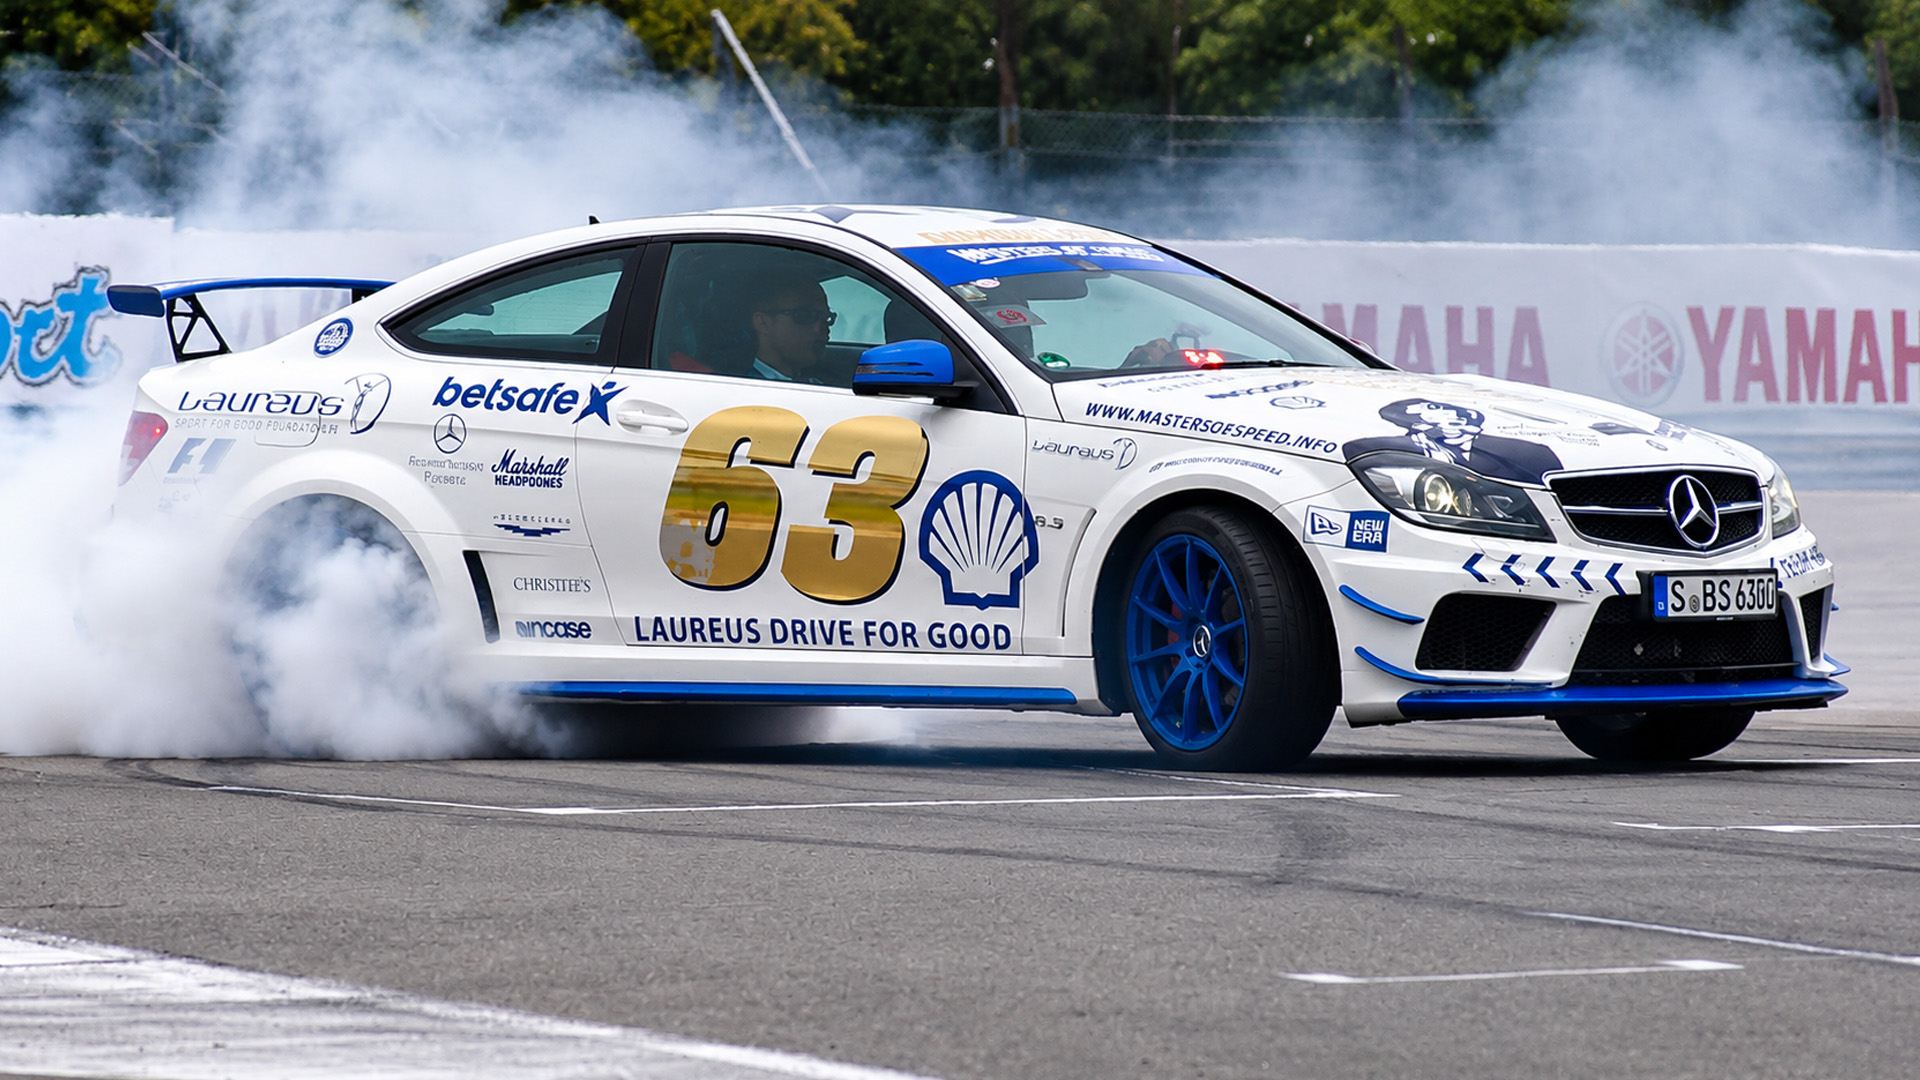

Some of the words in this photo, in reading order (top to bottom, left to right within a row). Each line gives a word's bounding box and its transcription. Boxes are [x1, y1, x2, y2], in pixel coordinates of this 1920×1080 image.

[432, 376, 579, 415] betsafe
[491, 449, 569, 476] Marshall
[659, 405, 930, 604] 63
[1352, 530, 1383, 544] ERA
[1354, 519, 1384, 531] NEW
[1671, 580, 1686, 612] S
[1703, 579, 1731, 612] BS
[526, 621, 591, 638] incase
[634, 616, 760, 644] LAUREUS
[770, 617, 854, 646] DRIVE
[864, 620, 920, 647] FOR
[928, 621, 1011, 650] GOOD
